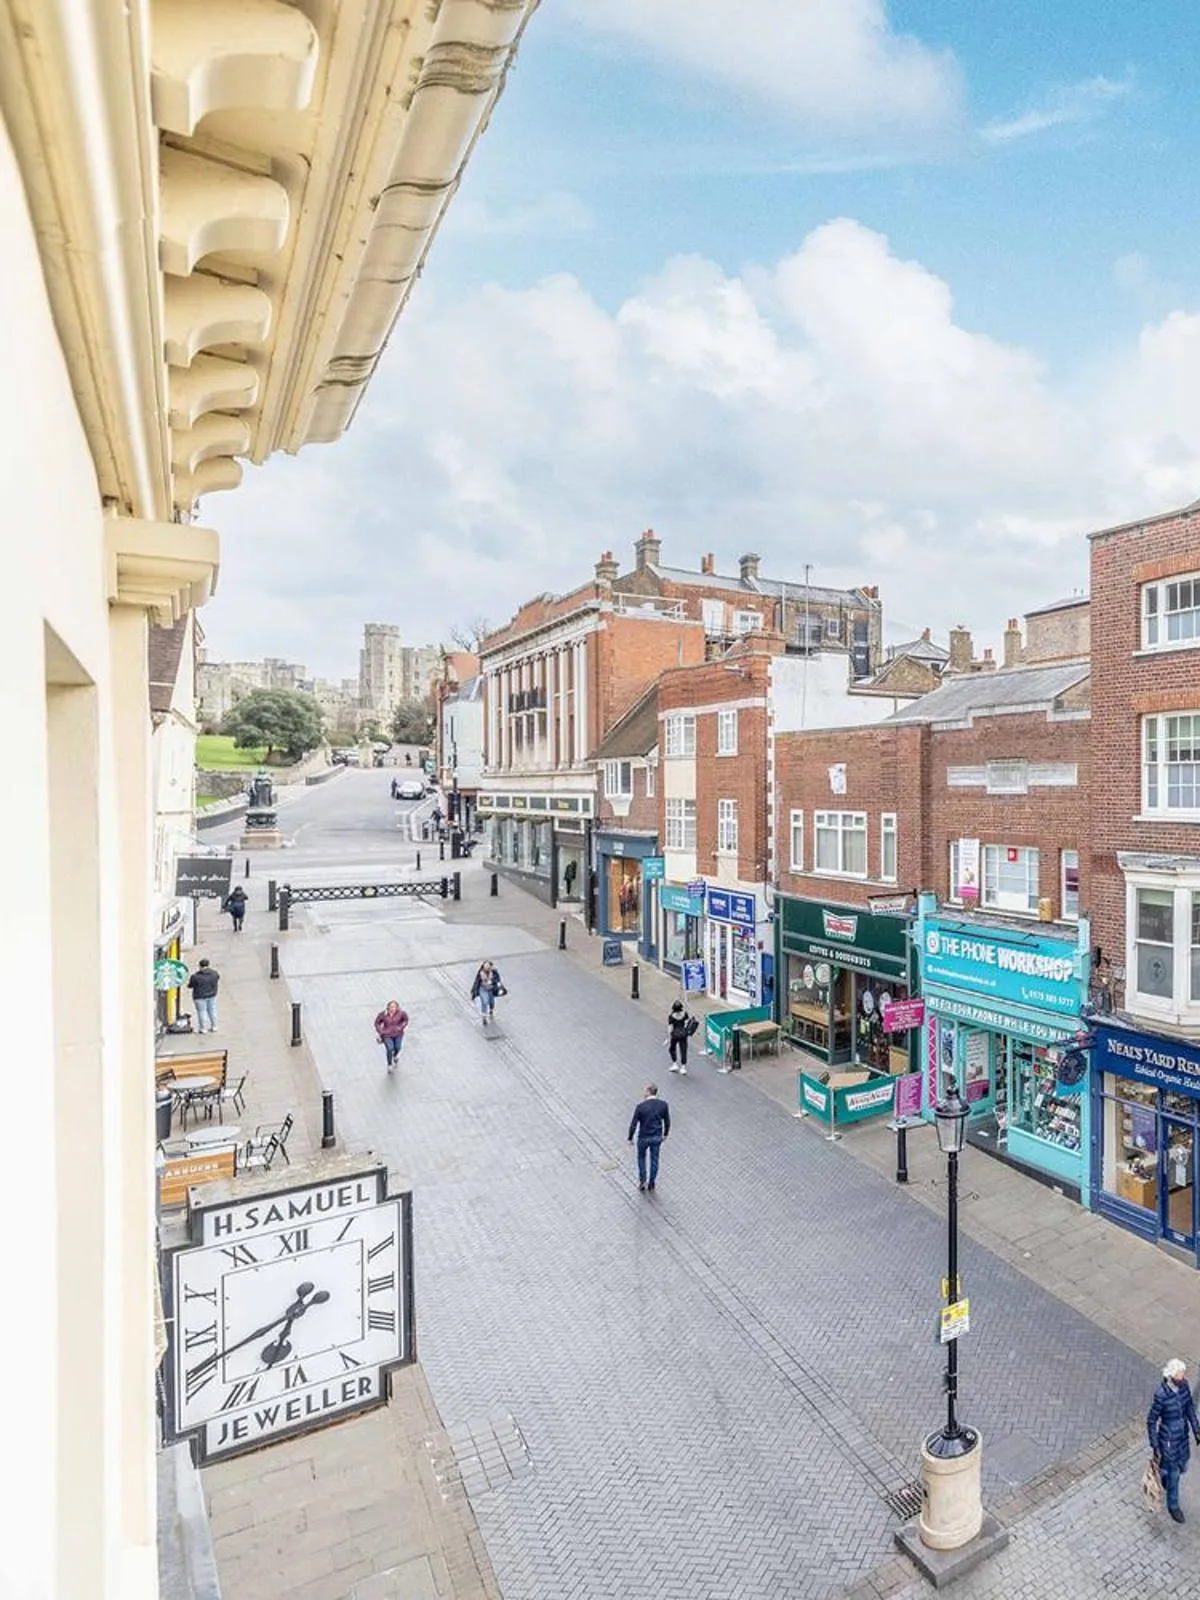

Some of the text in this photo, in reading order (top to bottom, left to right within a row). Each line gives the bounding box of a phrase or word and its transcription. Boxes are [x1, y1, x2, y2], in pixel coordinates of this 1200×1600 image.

[940, 935, 960, 957] THE
[961, 940, 996, 964] PHONE
[997, 948, 1074, 982] WORKSHOP
[1144, 1047, 1175, 1069] YARD
[278, 1228, 312, 1257] XII
[217, 1376, 373, 1445] JEWELLER
